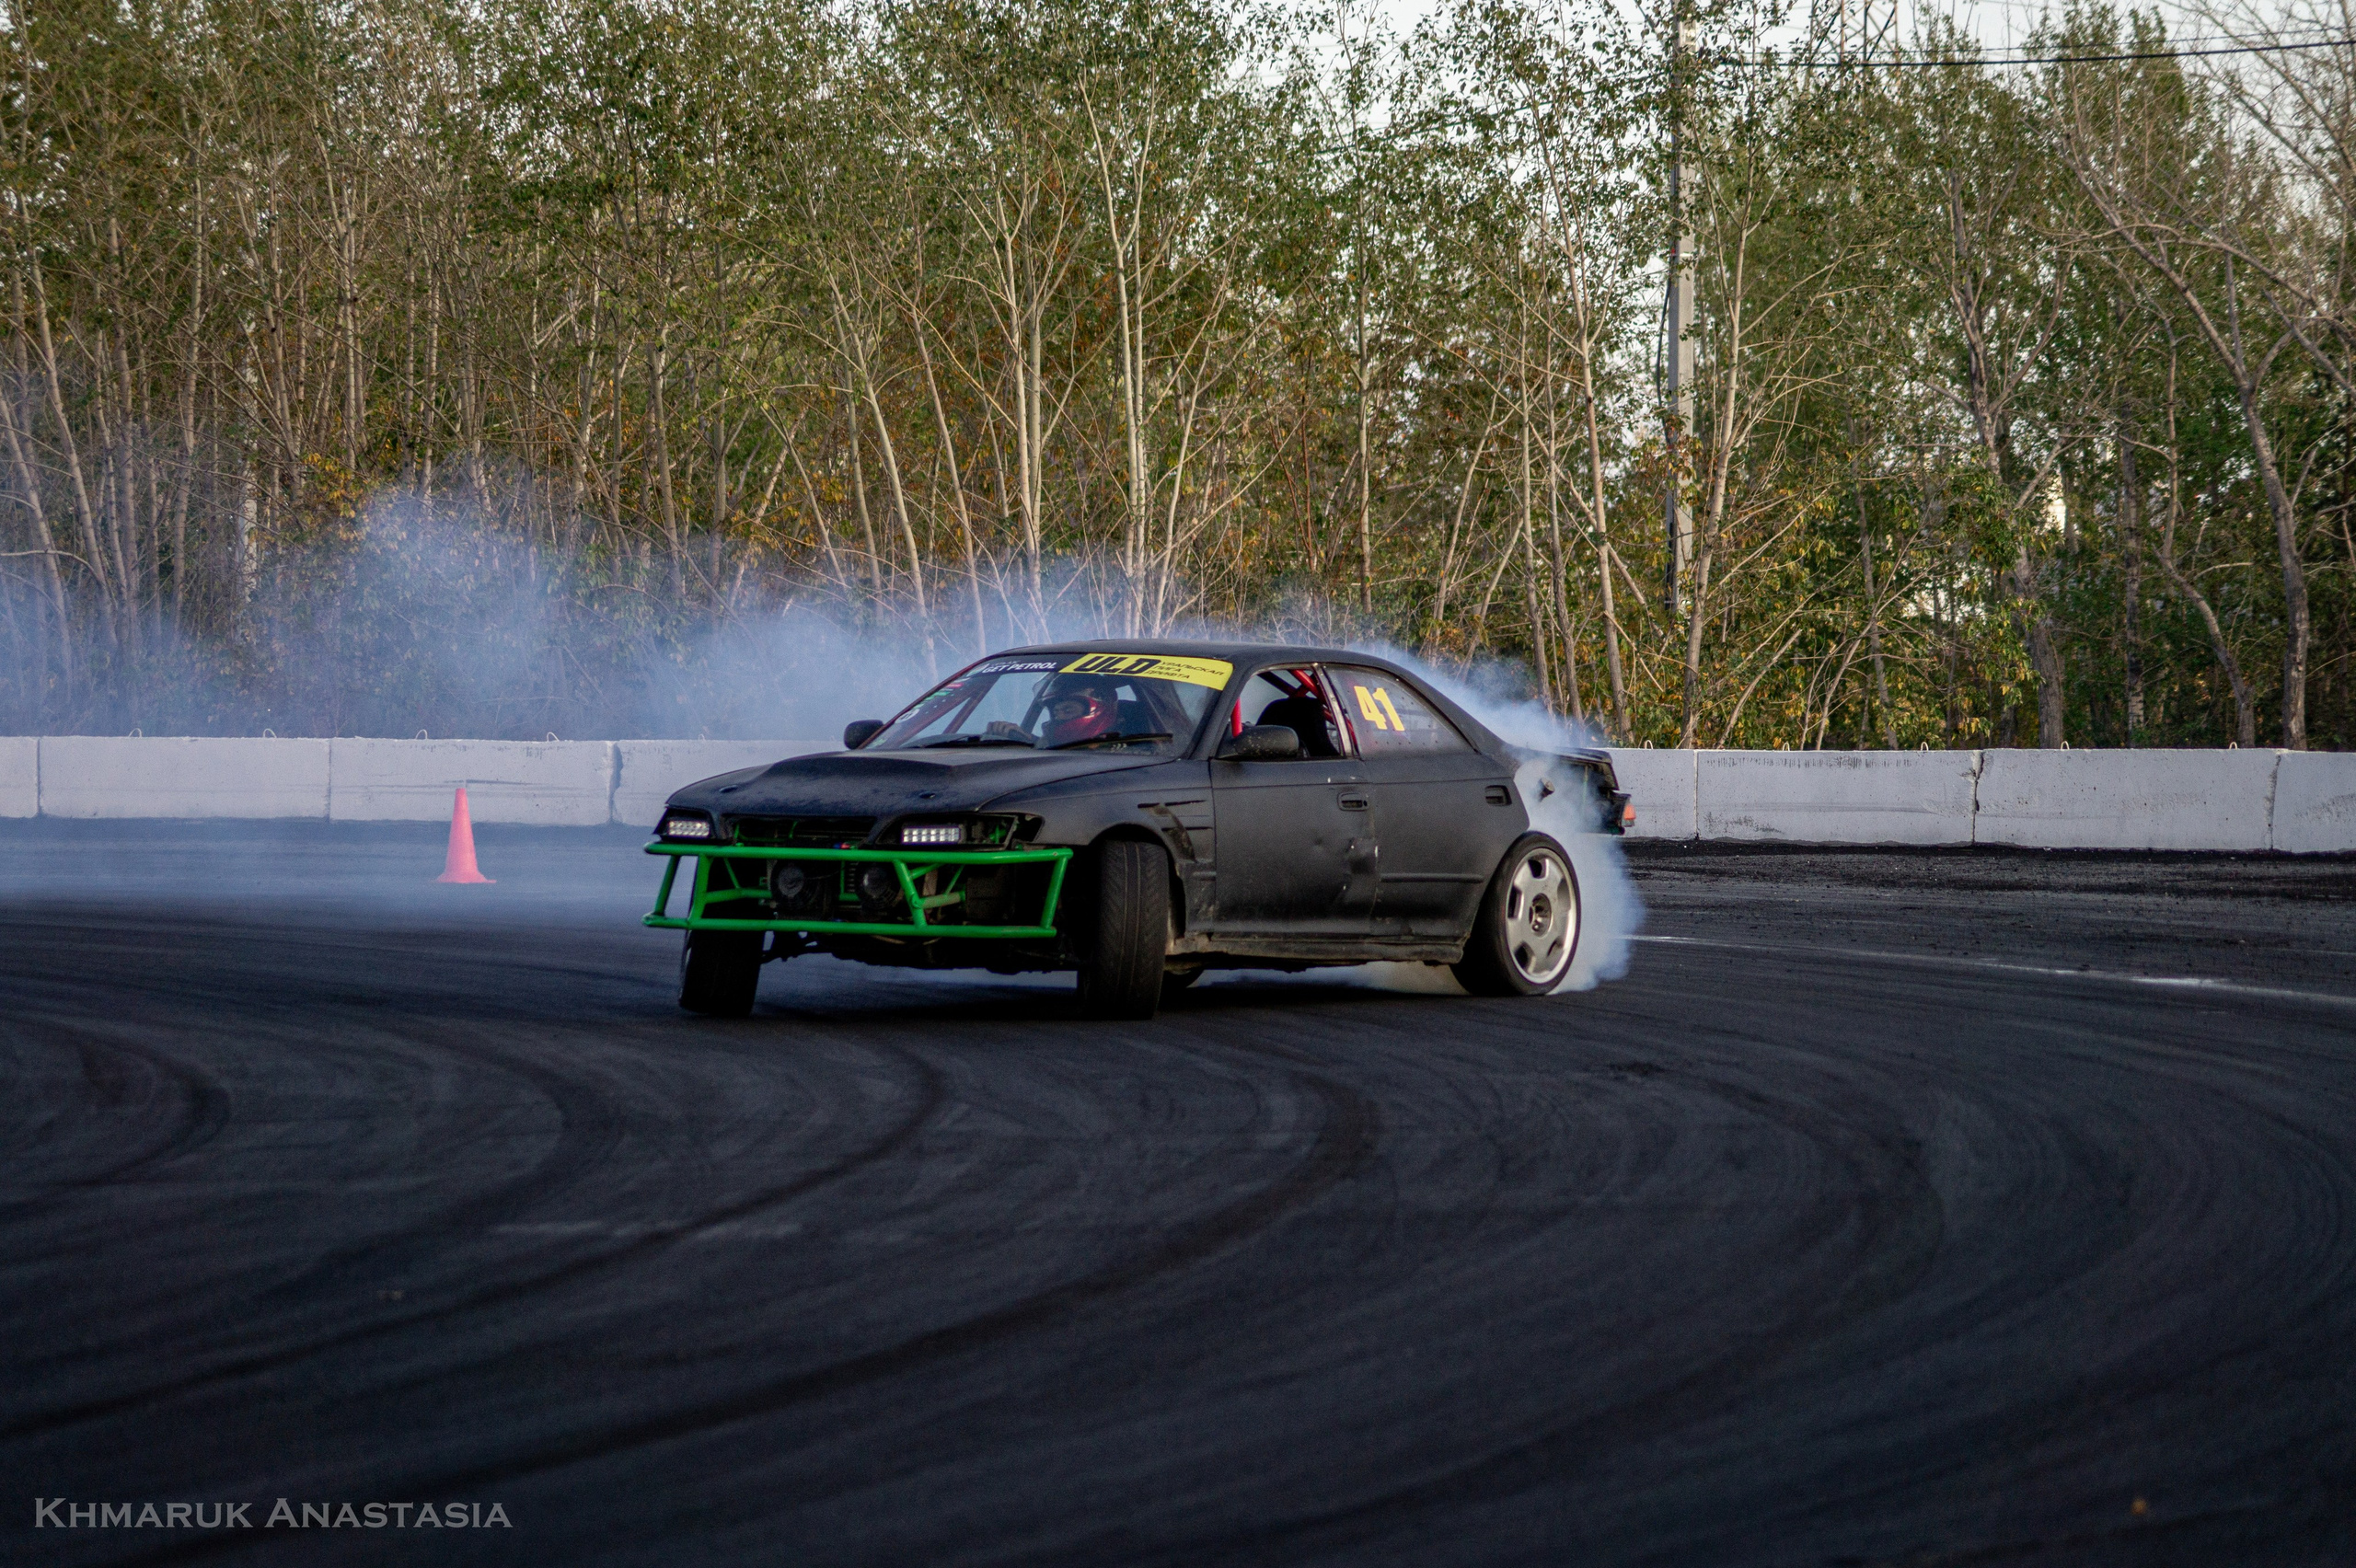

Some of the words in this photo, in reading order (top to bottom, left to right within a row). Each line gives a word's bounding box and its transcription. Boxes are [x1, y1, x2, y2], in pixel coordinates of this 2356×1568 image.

[982, 664, 1009, 674] GET
[1007, 662, 1057, 671] PETROL
[1073, 655, 1161, 674] ULD
[1354, 686, 1405, 732] 41
